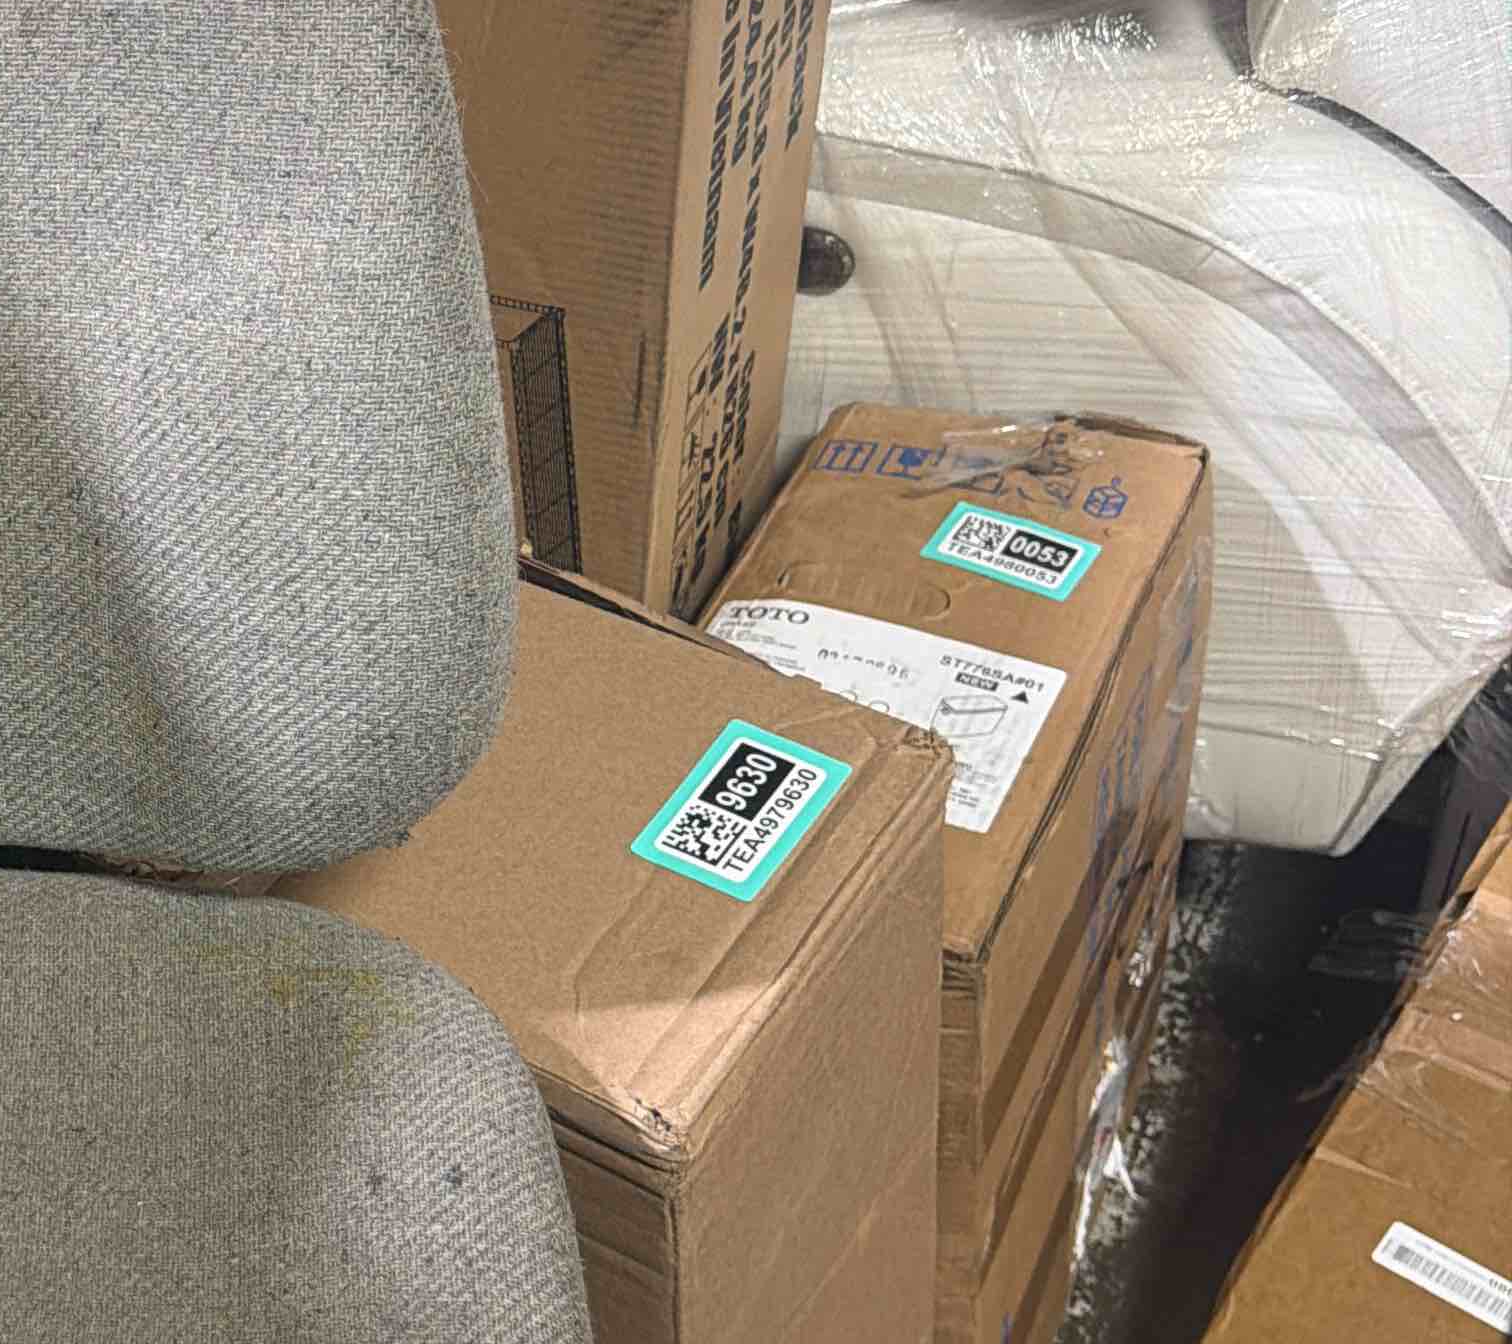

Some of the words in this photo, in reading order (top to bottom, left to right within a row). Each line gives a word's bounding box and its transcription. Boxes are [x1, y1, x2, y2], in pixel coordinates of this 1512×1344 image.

[698, 77, 737, 293] Vietnam
[945, 540, 1060, 587] TEA4980053
[1008, 534, 1071, 569] 0053
[726, 604, 811, 628] TOTO
[714, 751, 778, 812] 9630
[721, 767, 818, 875] TEA4979630
